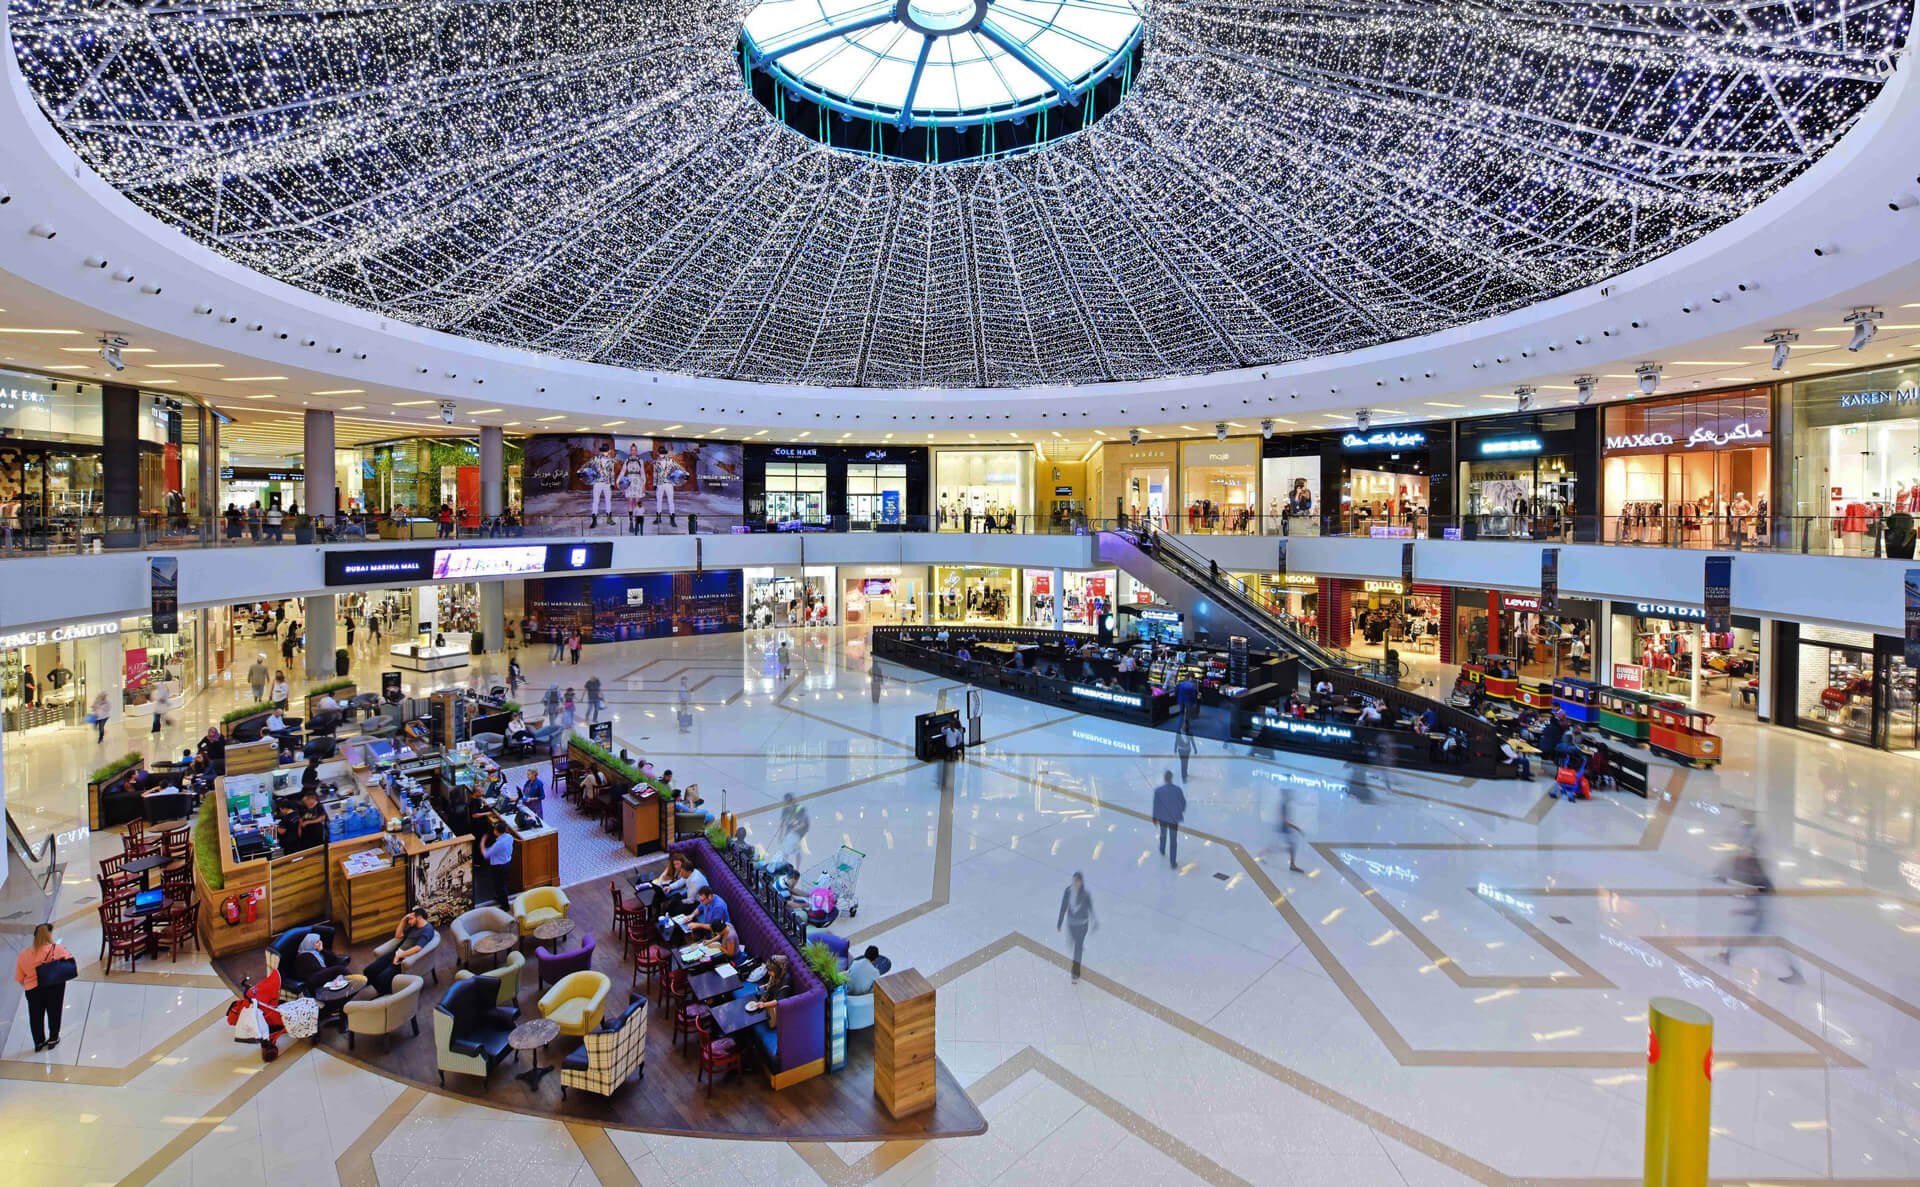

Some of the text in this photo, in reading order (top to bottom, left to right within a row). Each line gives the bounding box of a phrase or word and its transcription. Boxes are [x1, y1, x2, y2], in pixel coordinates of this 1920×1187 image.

[1840, 392, 1892, 408] KAREN
[775, 448, 795, 456] COLE
[345, 565, 369, 573] DUBAI
[370, 563, 400, 571] MARINA
[1271, 575, 1316, 585] MNSOON
[51, 622, 118, 641] CAMUTO
[1616, 673, 1639, 682] OFFERS
[1072, 686, 1142, 707] STARBUCKS COFFEE
